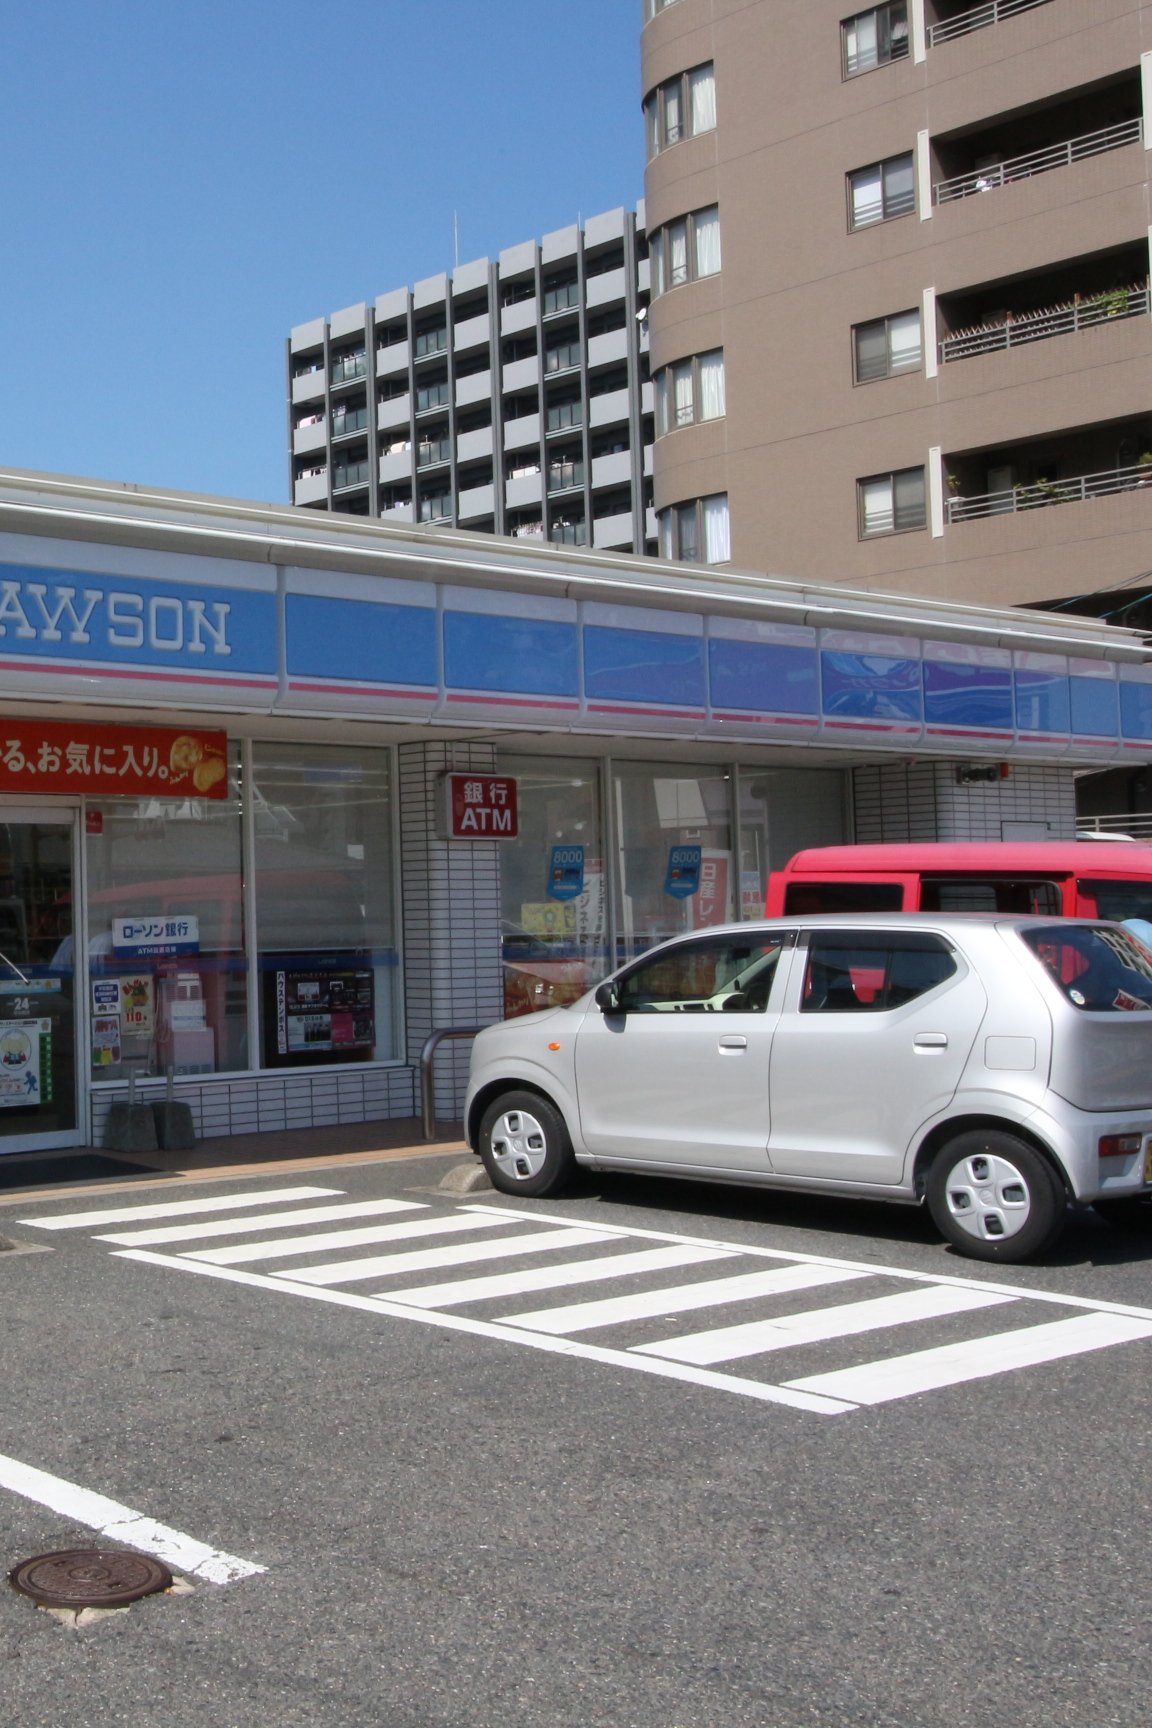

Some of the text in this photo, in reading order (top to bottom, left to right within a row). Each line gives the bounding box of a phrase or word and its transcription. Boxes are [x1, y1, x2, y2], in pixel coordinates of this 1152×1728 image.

[463, 782, 508, 805] 銀行
[460, 807, 512, 831] ATM
[553, 851, 583, 864] 8000
[671, 851, 700, 863] 8000
[123, 922, 188, 939] ローソン銀行
[13, 998, 29, 1010] 24
